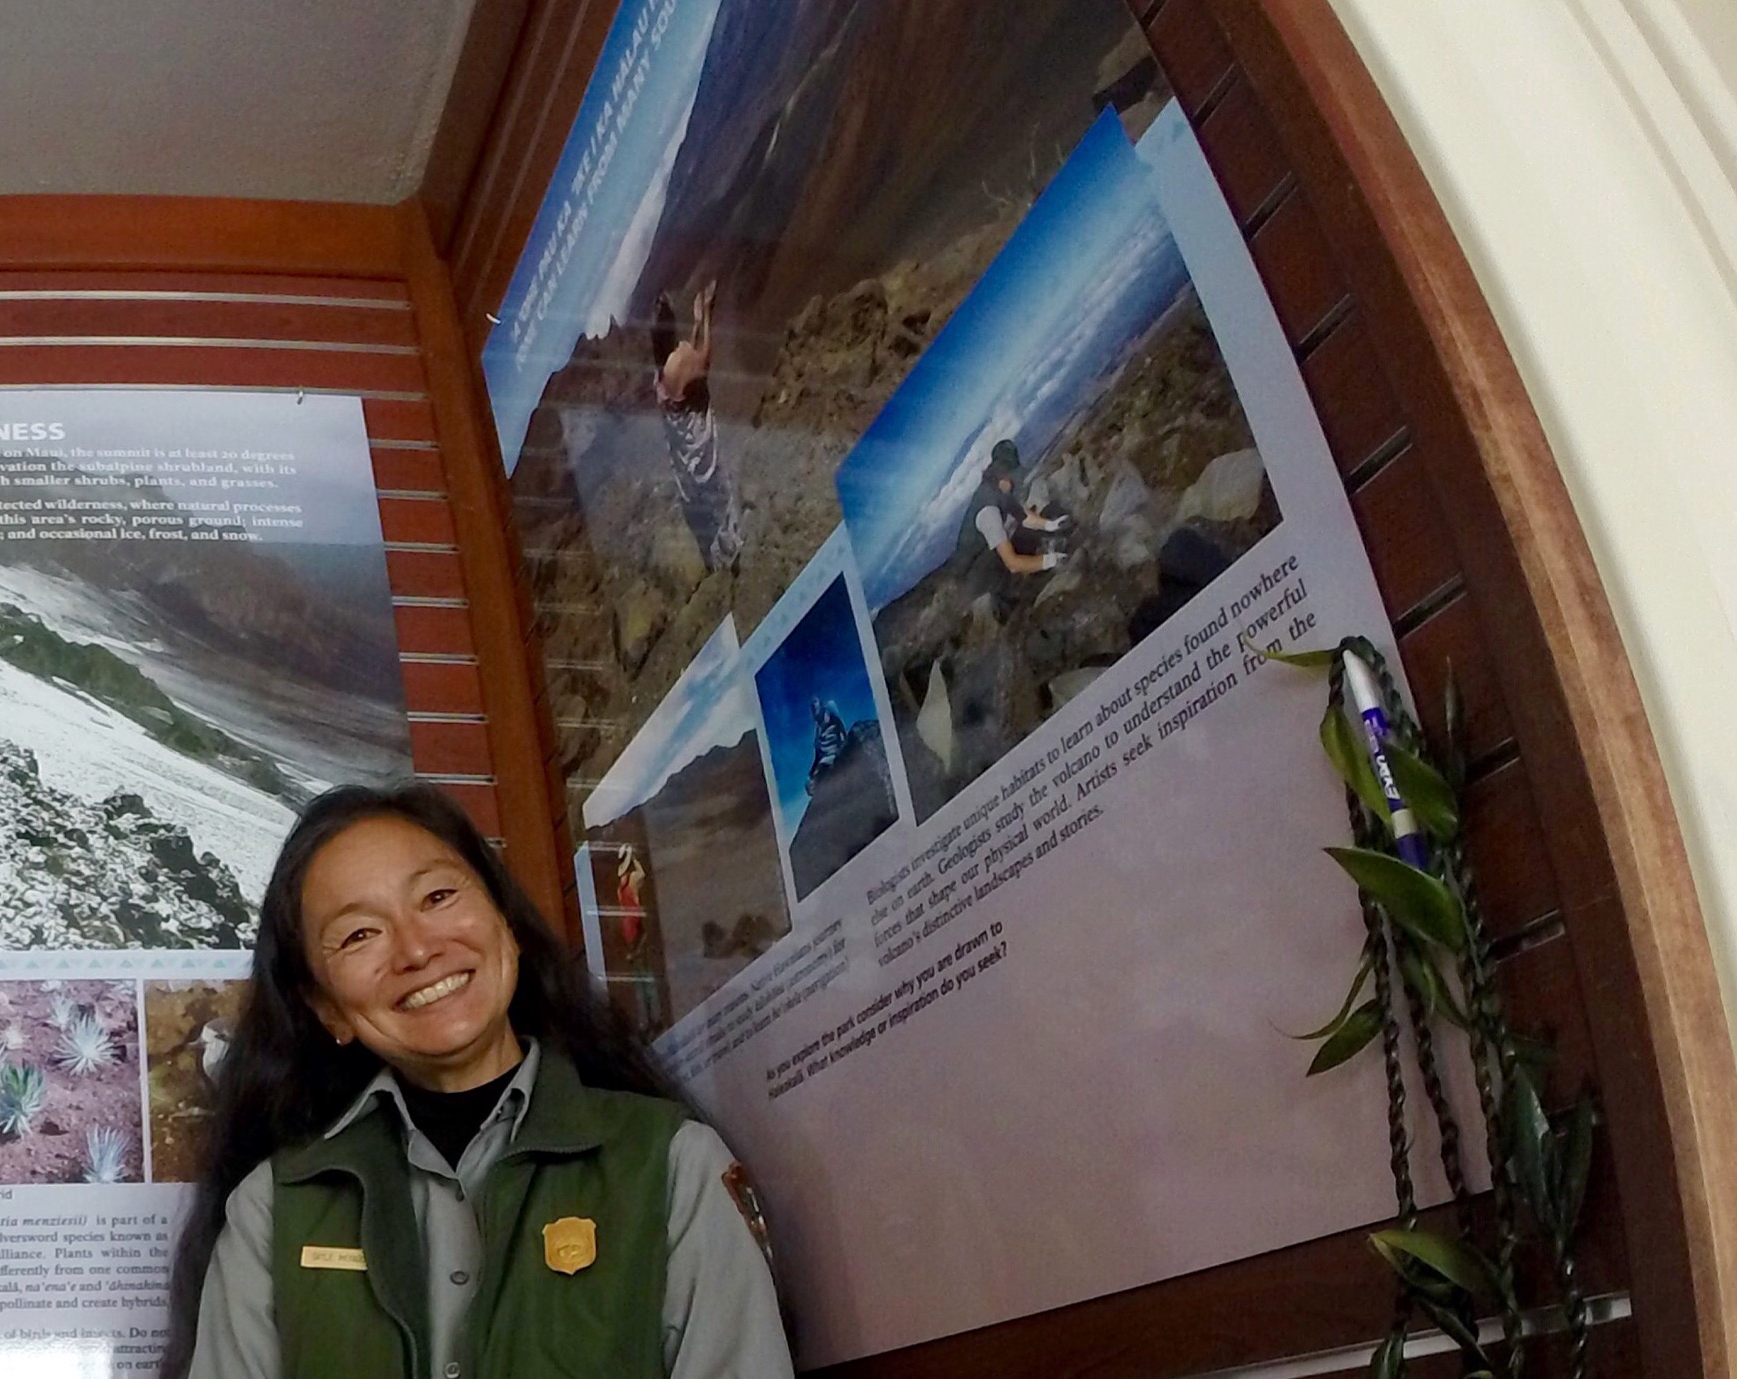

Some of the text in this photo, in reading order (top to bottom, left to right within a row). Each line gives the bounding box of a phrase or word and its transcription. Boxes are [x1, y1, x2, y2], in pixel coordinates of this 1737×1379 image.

[13, 474, 71, 486] smaller
[74, 473, 130, 486] shrubs,
[134, 473, 184, 488] plants,
[189, 476, 218, 487] and
[221, 478, 278, 490] grasses.
[44, 497, 128, 511] wilderness,
[129, 499, 174, 511] where
[178, 499, 229, 512] natural
[232, 503, 302, 514] processes
[962, 555, 1299, 831] unique habitats to learn about species found nowhere
[1077, 761, 1118, 802] Artists
[1122, 732, 1154, 767] seek
[1157, 672, 1239, 741] inspiration
[1288, 612, 1317, 642] the
[994, 802, 1024, 834] study
[1028, 784, 1048, 808] the
[1051, 745, 1101, 788] volcano
[1104, 730, 1119, 750] to
[1122, 660, 1202, 735] understand
[1206, 643, 1232, 671] the
[894, 921, 1003, 1000] why you are drawn to
[940, 940, 1007, 996] do you seek?
[62, 1231, 106, 1245] species
[109, 1230, 152, 1242] known
[155, 1232, 169, 1242] as
